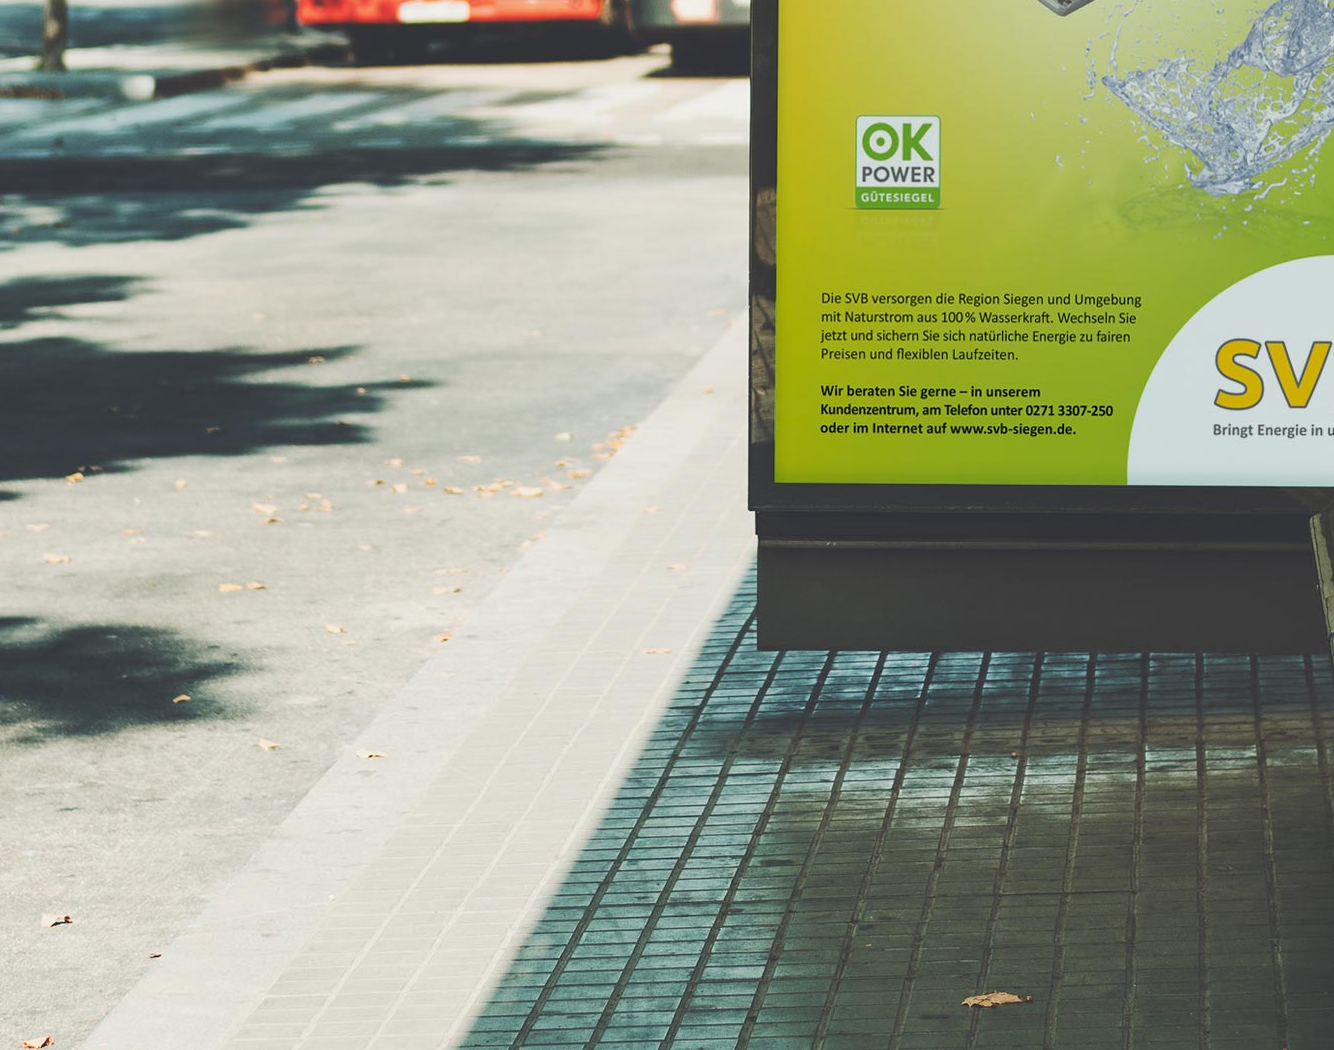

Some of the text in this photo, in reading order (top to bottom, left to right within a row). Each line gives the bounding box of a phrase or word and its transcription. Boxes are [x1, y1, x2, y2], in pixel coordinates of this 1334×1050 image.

[862, 122, 934, 161] OK
[862, 166, 935, 183] POWER
[861, 191, 934, 203] GÜTESIEGEL
[821, 291, 1142, 308] Die SVB versorgen die Region Siegen und Umgebung
[820, 310, 842, 323] mit
[844, 310, 914, 324] Naturstrom
[916, 313, 938, 324] aus
[978, 310, 1054, 324] Wasserkraft.
[1056, 311, 1116, 325] Wechseln
[1118, 311, 1137, 325] Sie
[819, 328, 1131, 345] jetzt und sichern Sie sich natürliche Energie zu fairen
[820, 347, 1019, 361] Preisen und flexiblen Laufzeiten.
[820, 384, 844, 397] Wir
[846, 384, 896, 398] beraten
[898, 384, 918, 398] Sie
[919, 387, 957, 400] gerne
[970, 385, 983, 398] in
[985, 388, 1041, 398] unserem
[820, 402, 1114, 418] Kundenzentrum, am Telefon unter 0271 3307-250
[819, 421, 1077, 438] oder im Internet auf www.svb-siegen.de.
[1212, 422, 1254, 439] Bringt
[1257, 423, 1308, 439] Energie
[1310, 423, 1324, 437] in
